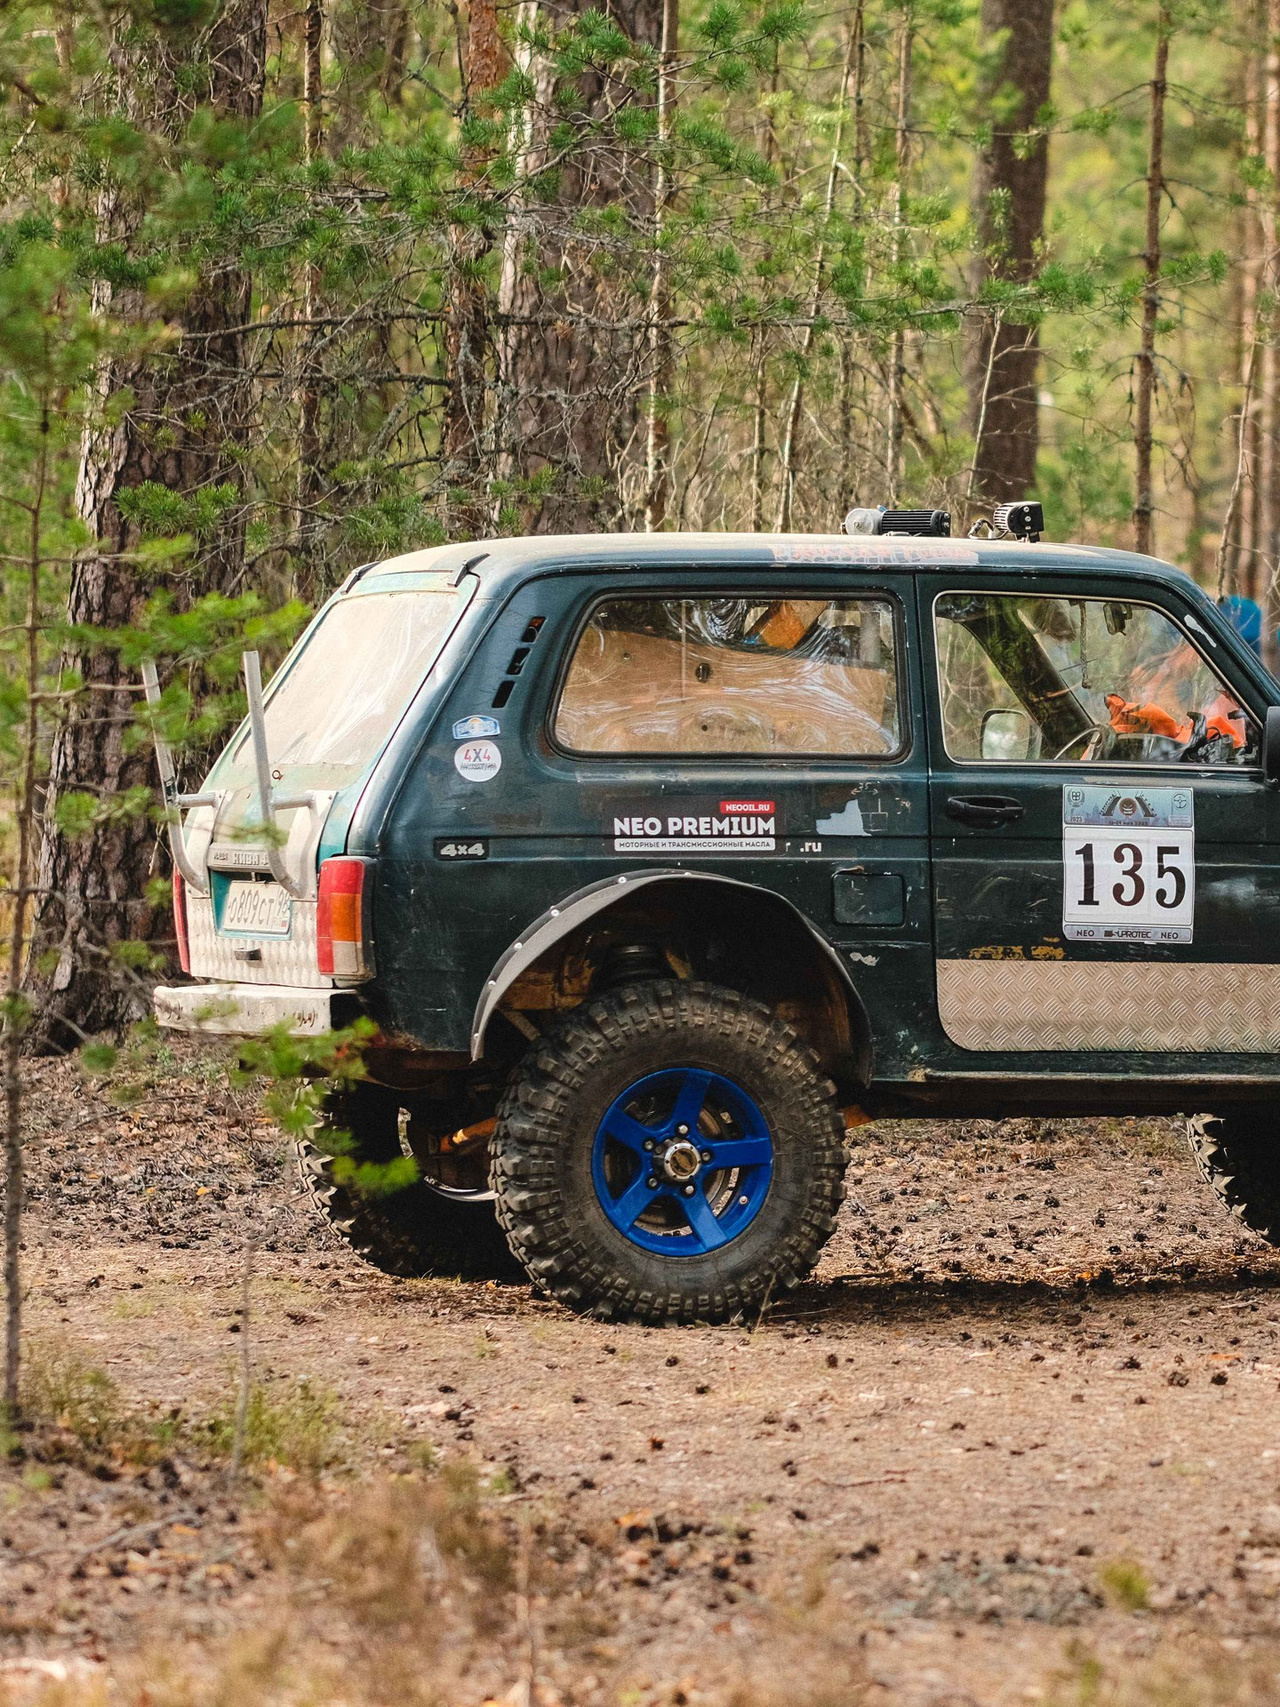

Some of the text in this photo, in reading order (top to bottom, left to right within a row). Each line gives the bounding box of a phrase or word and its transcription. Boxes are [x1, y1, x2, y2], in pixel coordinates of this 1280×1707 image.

[463, 748, 491, 763] 4X4
[725, 803, 771, 812] NEOOIL.RU
[613, 816, 776, 836] NEO PREMIUM
[440, 843, 485, 857] 4x4
[800, 842, 822, 852] .ru
[1075, 843, 1186, 909] 135
[1160, 932, 1179, 940] NEO
